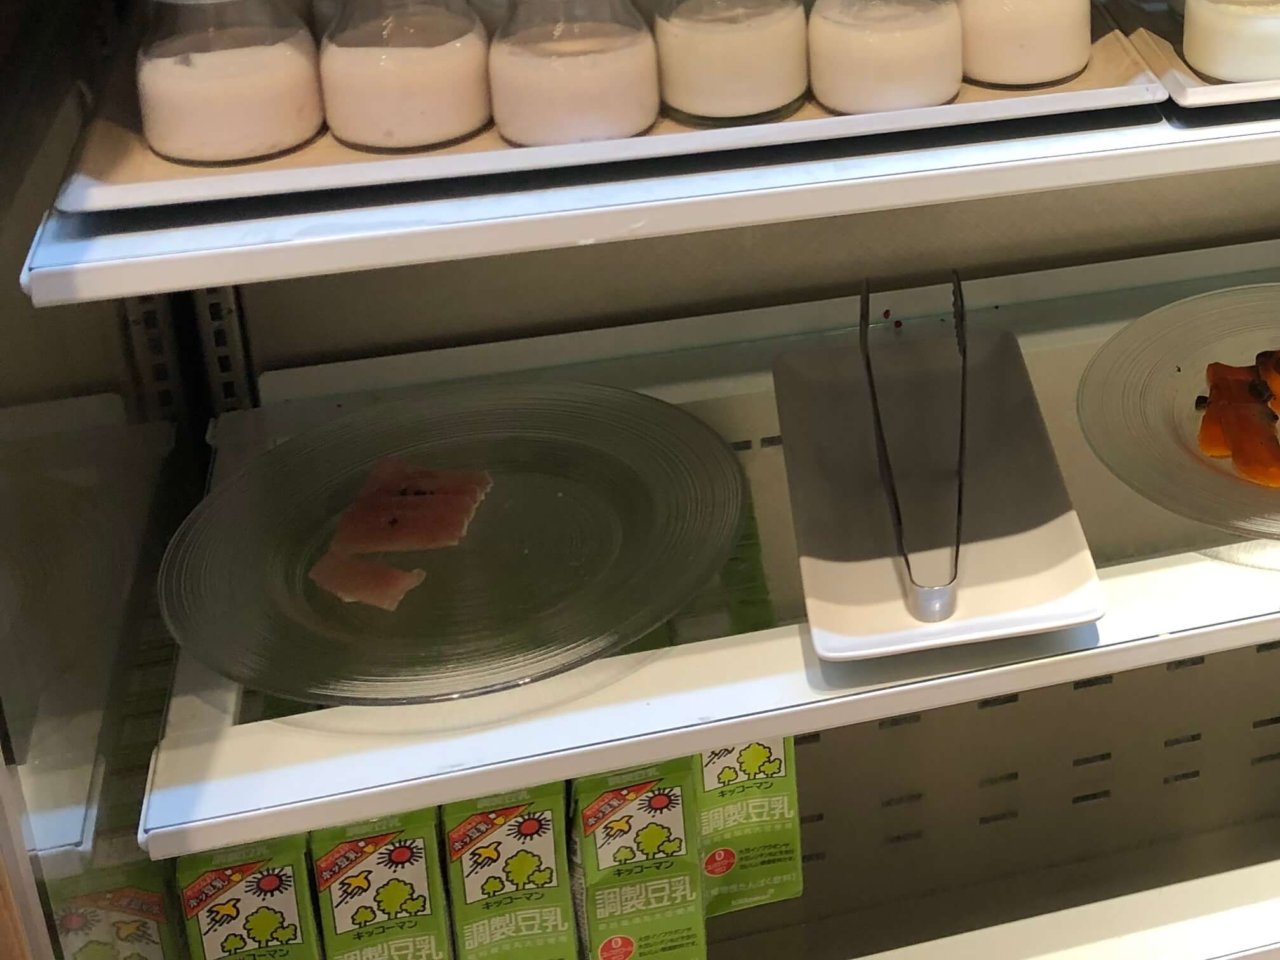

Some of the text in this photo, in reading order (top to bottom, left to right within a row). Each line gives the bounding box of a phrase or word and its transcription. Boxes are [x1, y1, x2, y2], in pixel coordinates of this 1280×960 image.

[717, 781, 774, 798] キッコーマン
[701, 796, 794, 836] 調製豆乳
[613, 860, 675, 878] キッコーマン
[481, 891, 545, 910] キッコーマン
[595, 876, 697, 919] 調製豆乳
[352, 920, 418, 941] キッコーマン
[463, 906, 569, 950] 調製豆乳
